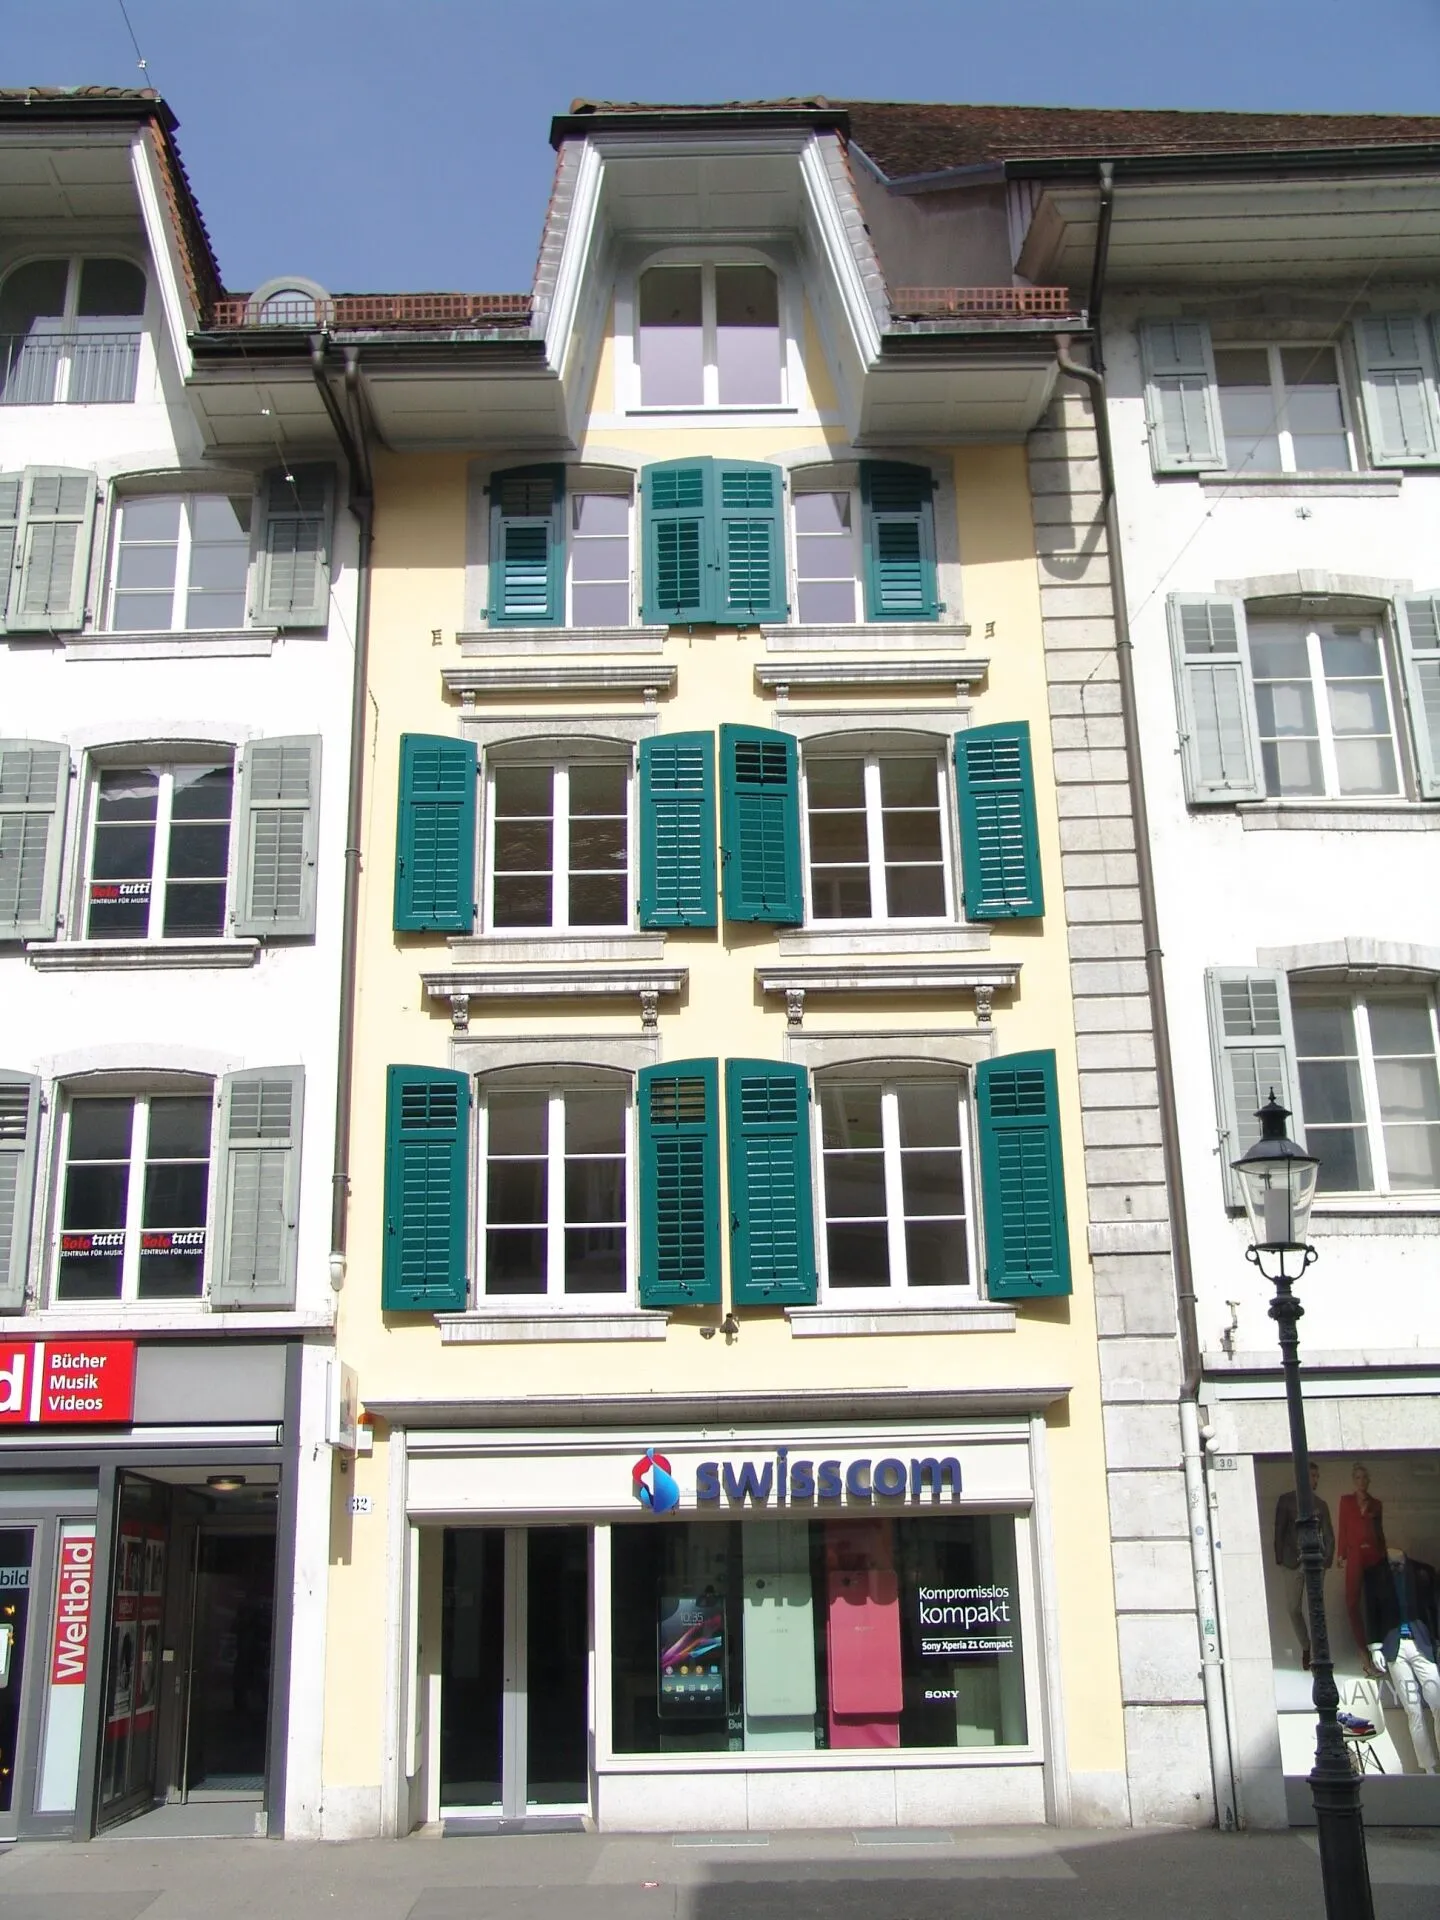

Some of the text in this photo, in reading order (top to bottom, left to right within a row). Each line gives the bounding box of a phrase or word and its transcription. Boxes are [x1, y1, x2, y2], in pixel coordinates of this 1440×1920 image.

[120, 883, 150, 895] tutti
[62, 1233, 124, 1249] Solo tutti
[142, 1231, 205, 1248] Solo tutti
[51, 1353, 107, 1369] Bücher
[50, 1374, 98, 1390] Musik
[48, 1395, 103, 1411] Videos
[1219, 1458, 1233, 1468] 30
[696, 1447, 963, 1498] swisscom
[352, 1497, 368, 1511] 32
[919, 1584, 1010, 1603] Kompromisslos
[56, 1542, 93, 1679] Weltbild
[920, 1600, 1011, 1630] kompakt
[922, 1639, 1013, 1652] Sony Xperia Z1 Compact
[924, 1690, 960, 1699] SONY
